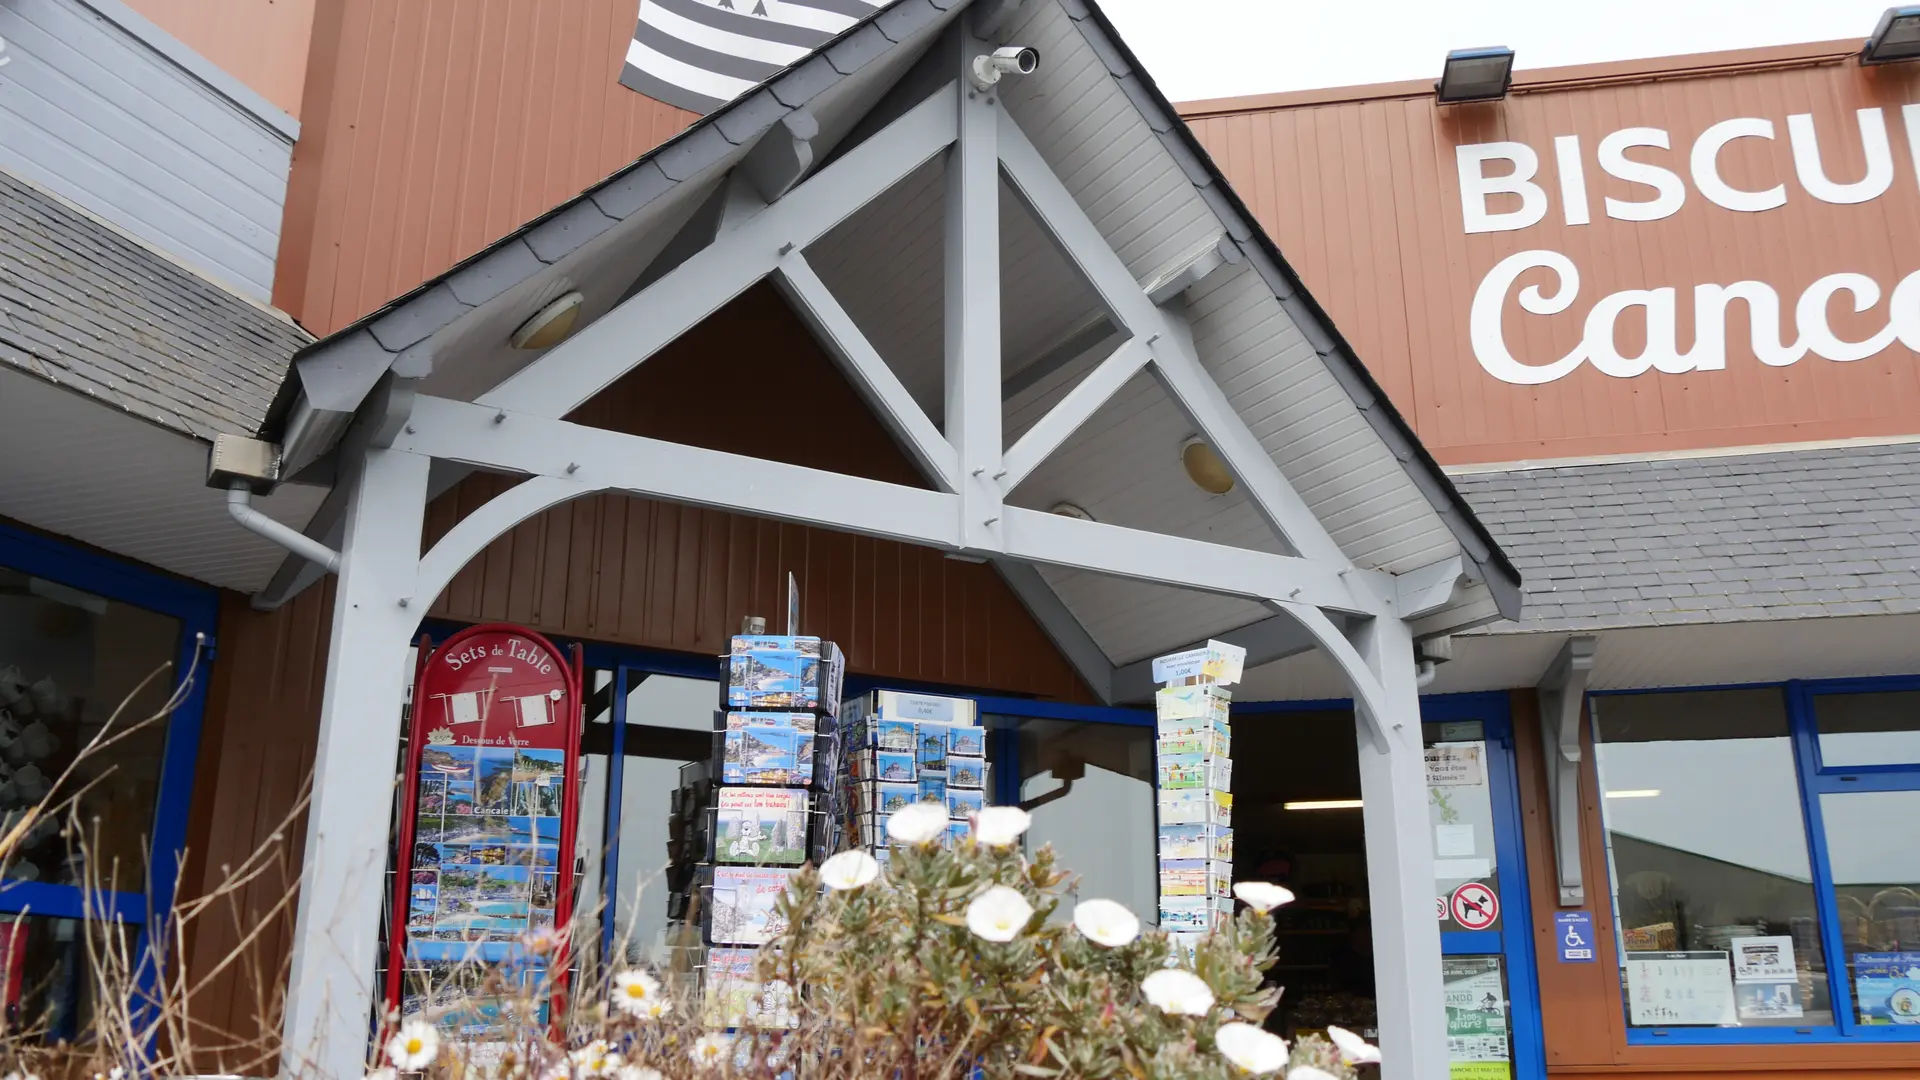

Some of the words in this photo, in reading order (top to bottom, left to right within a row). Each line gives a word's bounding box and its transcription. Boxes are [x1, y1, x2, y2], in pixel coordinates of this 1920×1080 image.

[445, 645, 487, 671] Sets
[491, 644, 504, 656] de
[508, 638, 552, 675] Table
[496, 735, 506, 745] de
[508, 735, 530, 746] Verre
[474, 806, 509, 815] Cancale
[1446, 993, 1473, 1002] ANDO
